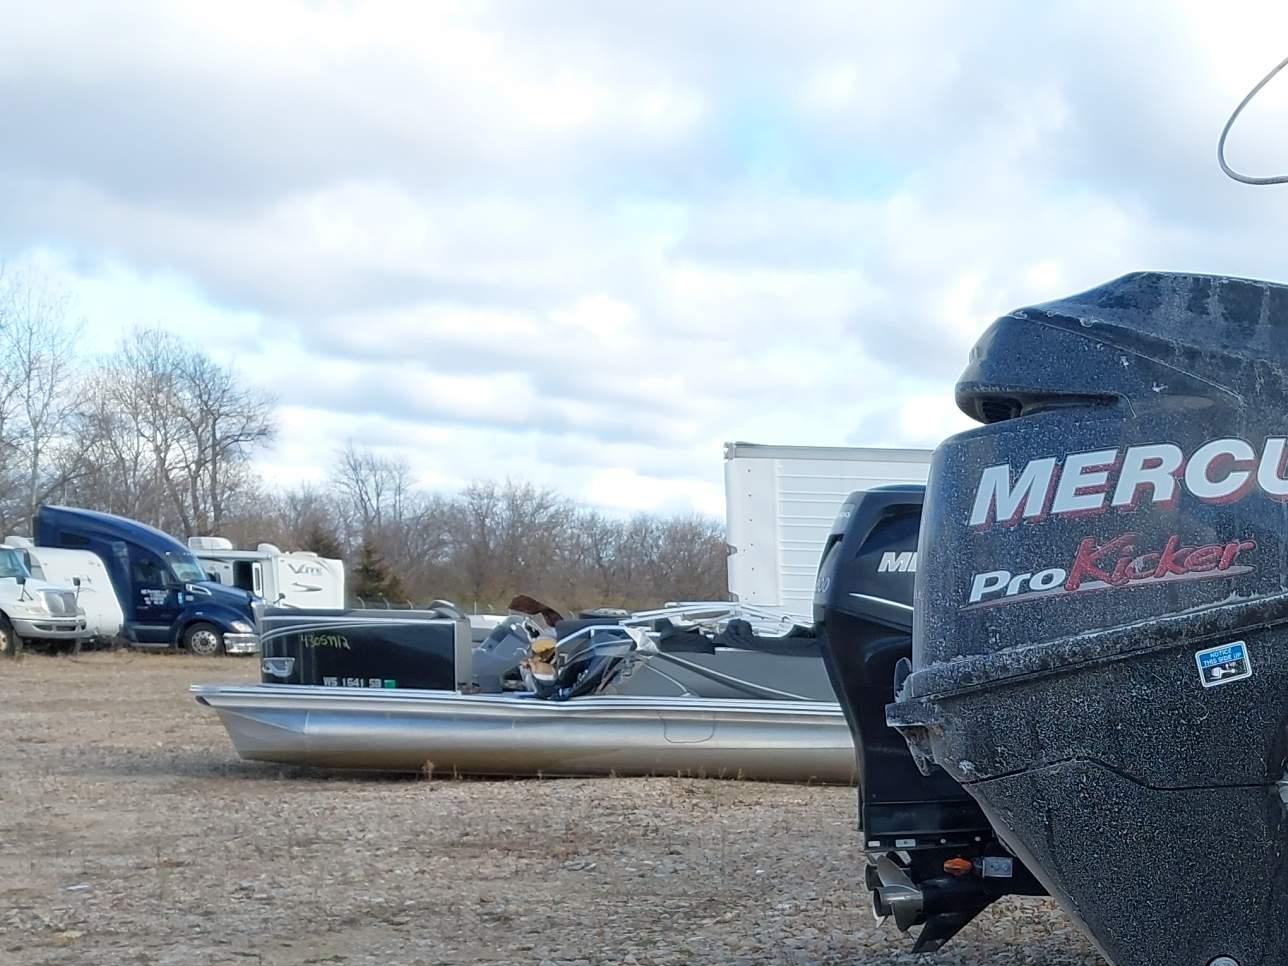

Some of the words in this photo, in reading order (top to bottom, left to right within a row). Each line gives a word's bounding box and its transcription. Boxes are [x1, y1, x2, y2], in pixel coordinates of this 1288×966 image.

[967, 566, 1066, 602] Pro
[1064, 532, 1257, 592] Kicker
[1210, 647, 1232, 658] NOTICE
[1202, 658, 1217, 667] THIS
[1218, 654, 1232, 662] SIDE
